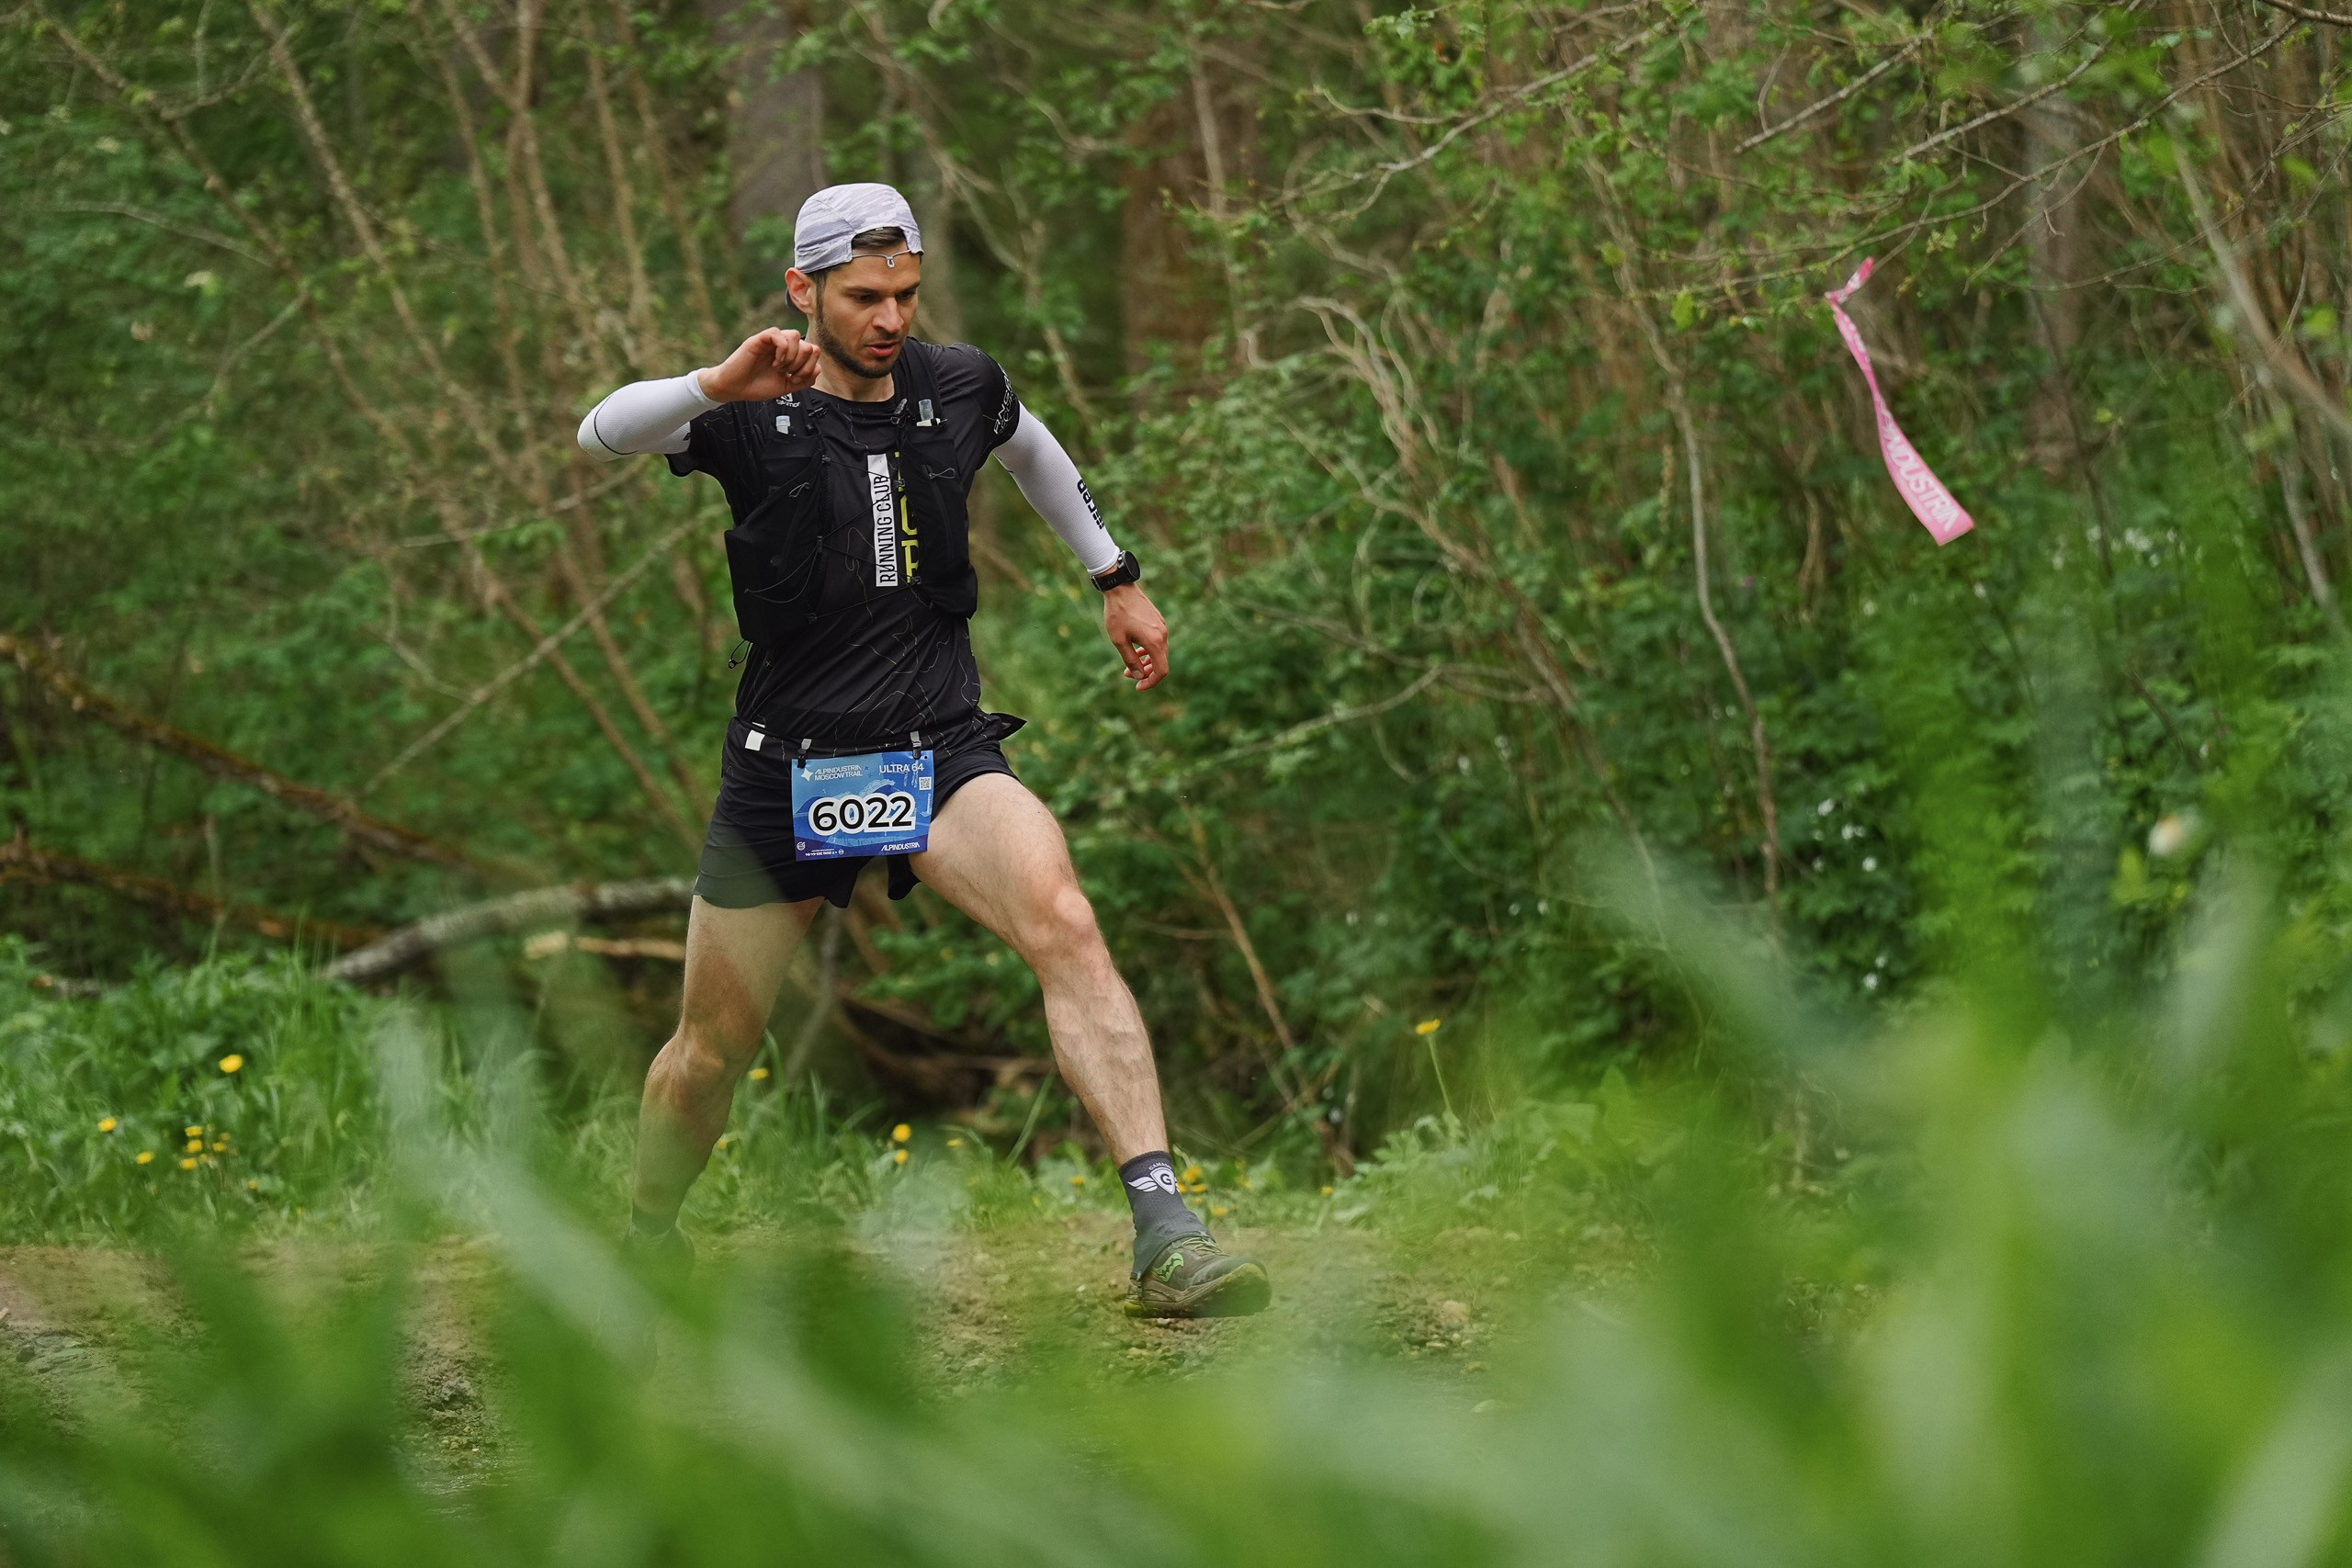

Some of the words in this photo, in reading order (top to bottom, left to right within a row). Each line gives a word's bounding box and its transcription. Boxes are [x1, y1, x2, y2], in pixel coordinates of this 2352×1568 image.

[874, 475, 891, 513] CLUB
[876, 516, 896, 583] RUNNING
[815, 765, 862, 774] ALPINDUSTRIA
[878, 763, 910, 773] ULTRA
[911, 762, 924, 772] 64
[815, 773, 844, 781] MOSCOW
[845, 770, 863, 778] TRAIL
[812, 795, 912, 831] 6022
[880, 841, 921, 852] ALPINDUSTRIA
[1160, 1173, 1172, 1186] G
